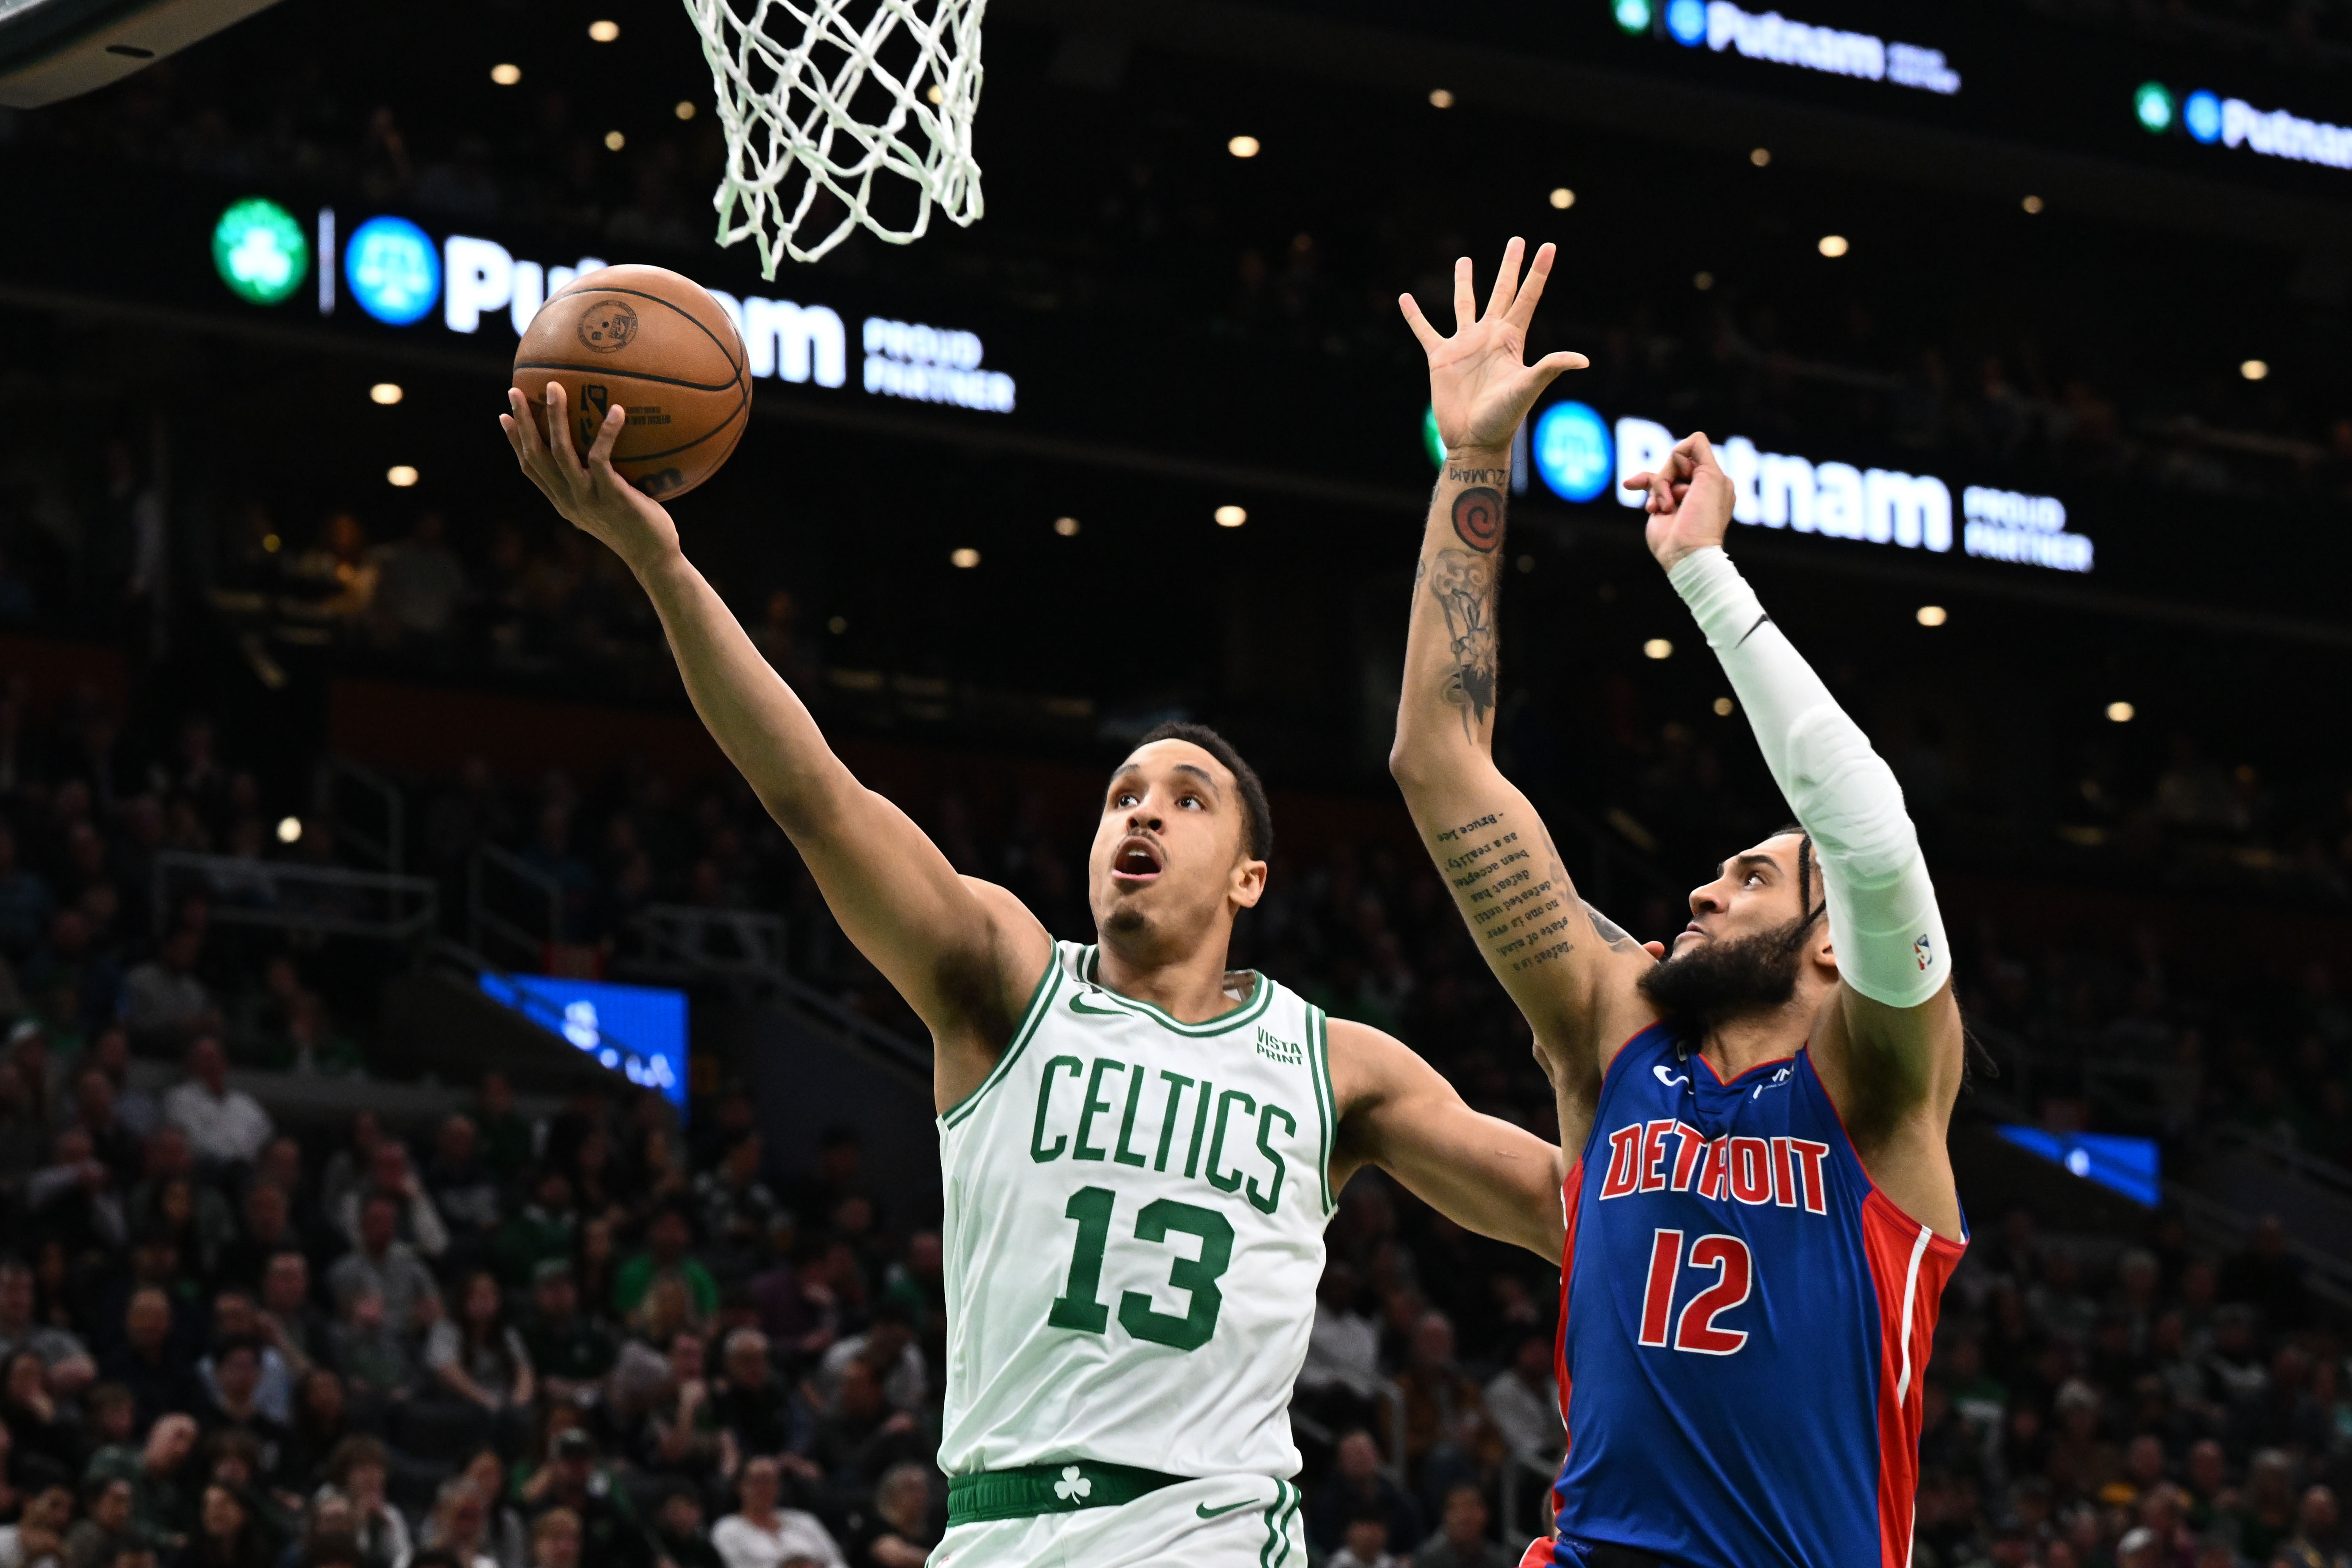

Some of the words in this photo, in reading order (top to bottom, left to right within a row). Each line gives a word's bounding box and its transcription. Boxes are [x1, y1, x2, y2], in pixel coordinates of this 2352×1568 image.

[2221, 98, 2352, 170] Putna
[863, 316, 984, 372] PROUD
[863, 354, 1016, 414] PARTNER
[1615, 416, 1953, 553] Ptnam
[1963, 485, 2067, 535] PROUD
[1459, 814, 1498, 834] Bruce
[1437, 829, 1459, 841] Lee
[1503, 832, 1517, 843] as
[1500, 850, 1529, 865] been
[1492, 869, 1529, 893] defeat
[1471, 888, 1493, 902] has
[1503, 881, 1551, 911] defeated
[1546, 899, 1559, 910] no
[1474, 906, 1503, 925] until
[1511, 916, 1524, 927] is
[1525, 907, 1544, 921] one
[1487, 924, 1508, 938] ever
[1540, 916, 1568, 936] state
[1526, 932, 1538, 945] of
[1521, 957, 1532, 968] is
[1258, 1025, 1302, 1055] VISTA
[1257, 1043, 1302, 1065] PRINT
[1030, 1055, 1297, 1215] CELTICS
[1599, 1118, 1829, 1216] DETROIT
[1048, 1185, 1235, 1352] 13
[1638, 1228, 1753, 1356] 12
